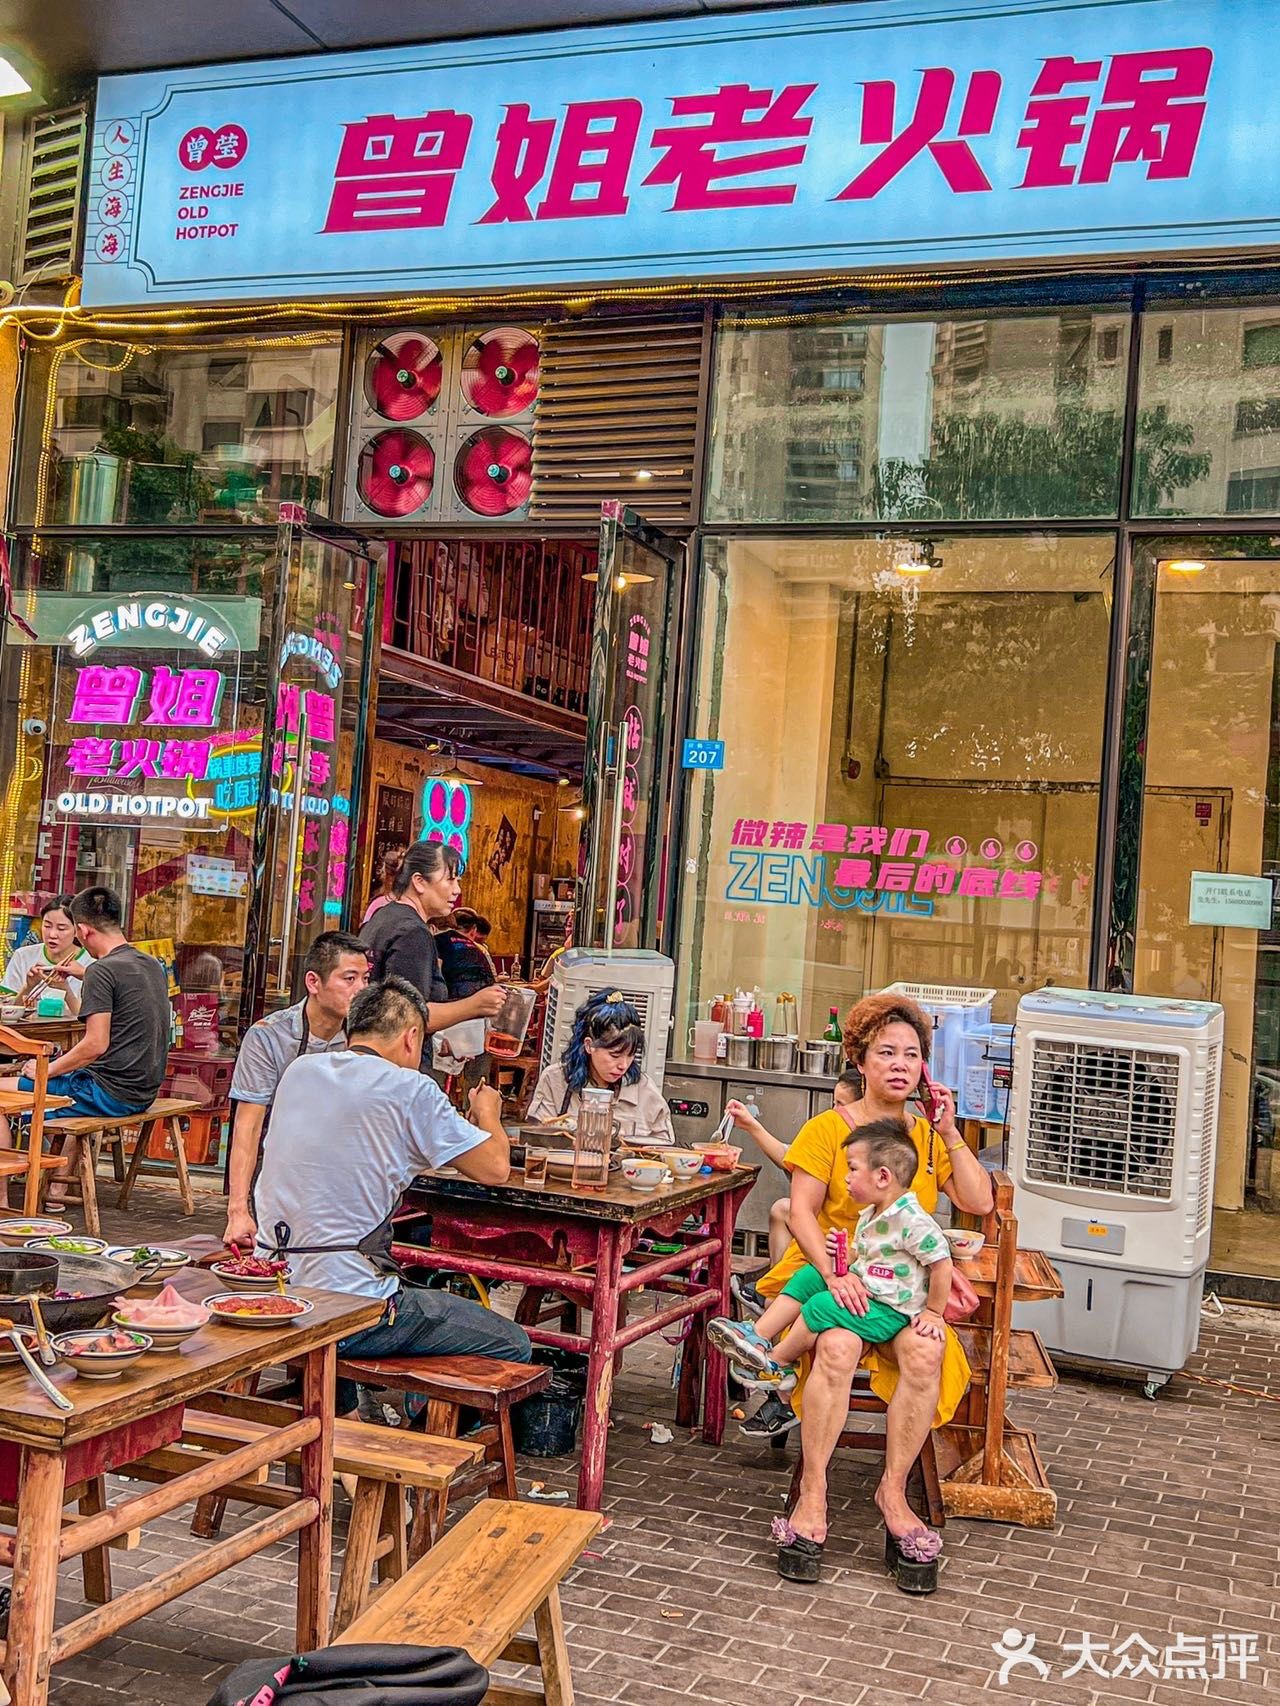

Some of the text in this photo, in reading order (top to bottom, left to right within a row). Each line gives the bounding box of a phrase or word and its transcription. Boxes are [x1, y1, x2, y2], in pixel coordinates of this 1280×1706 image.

[315, 46, 1213, 234] 曾姐老火锅
[101, 125, 130, 256] 人生海海
[179, 183, 245, 200] ZENGJIE
[175, 224, 239, 240] HOTPOT
[177, 206, 209, 220] OLD
[67, 602, 229, 660] ZENGJIE
[67, 665, 229, 727] 曾姐
[66, 737, 213, 781] 老火锅
[688, 750, 717, 764] 207
[56, 791, 214, 820] OLD HOTPOT
[730, 818, 930, 859] 微辣是我们
[832, 858, 1044, 901] 最后的底线
